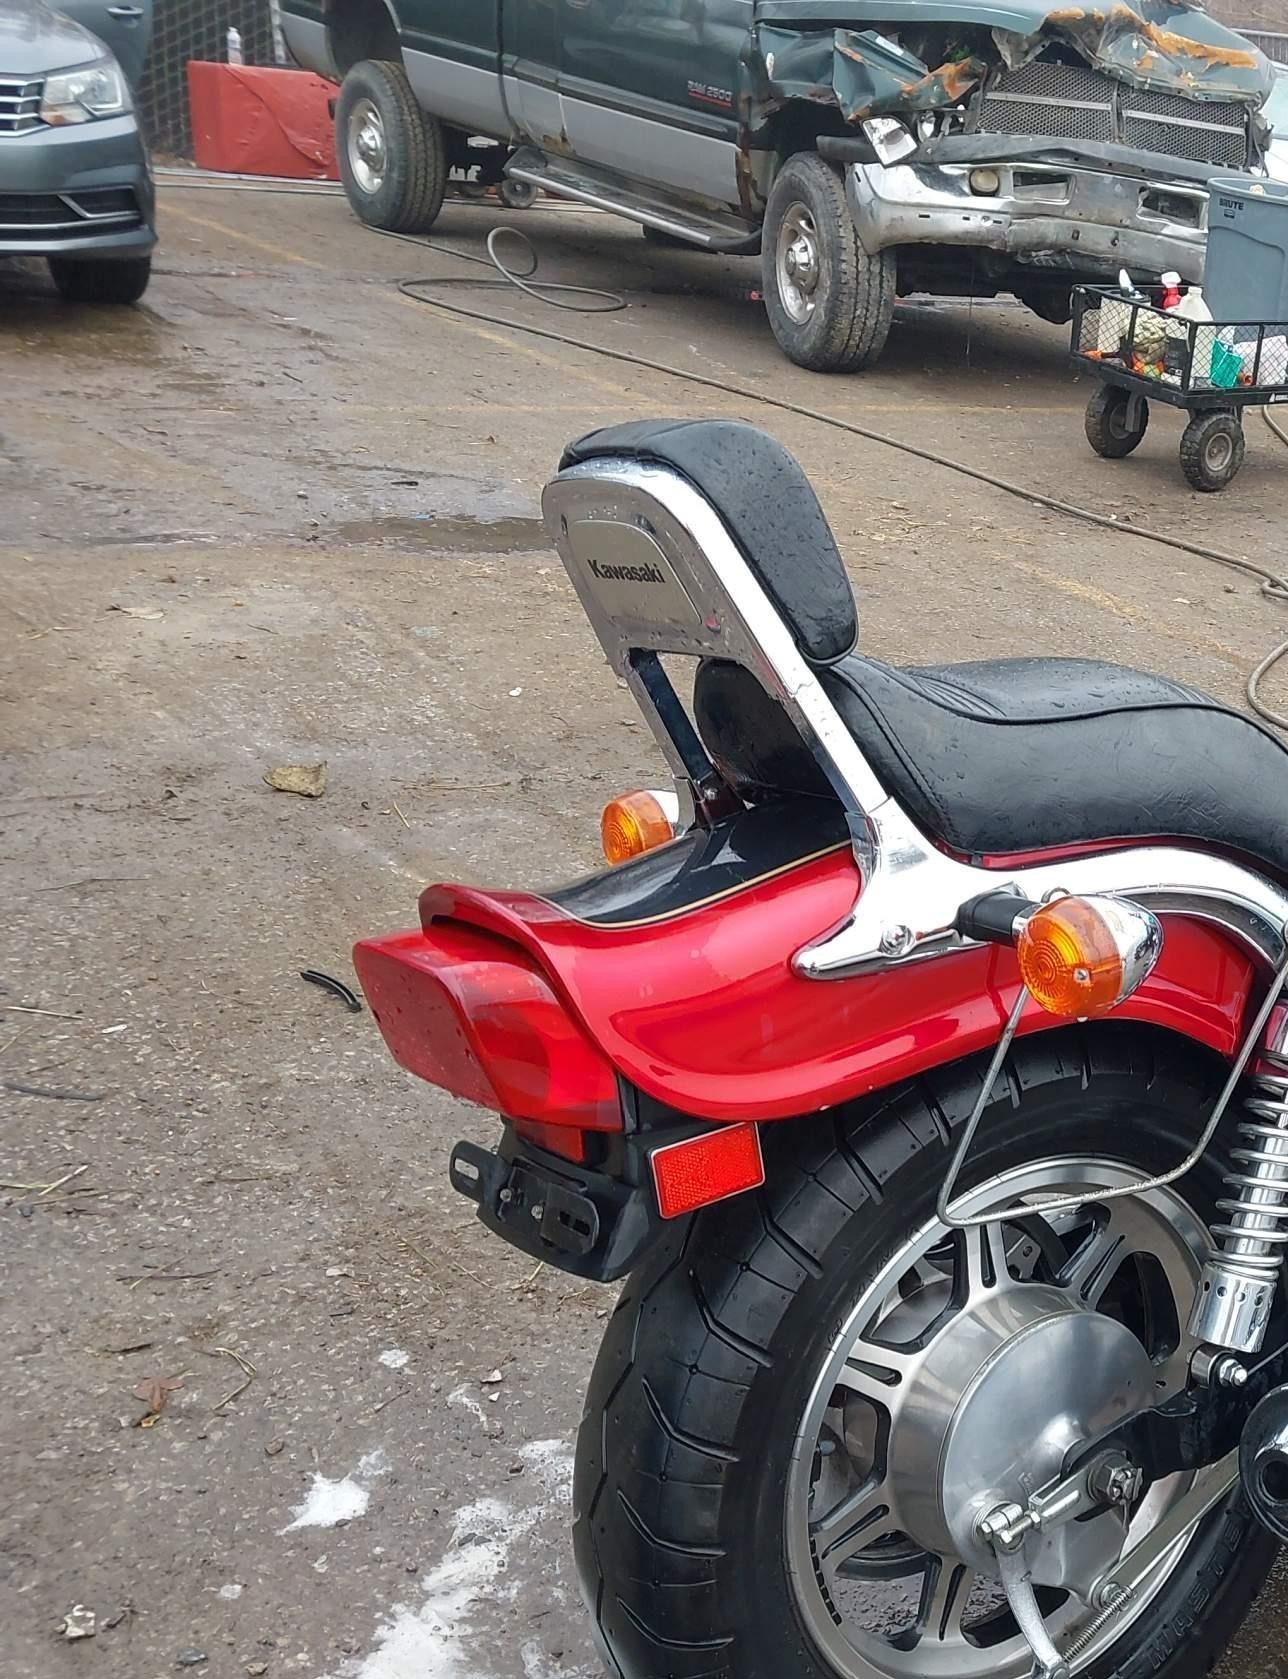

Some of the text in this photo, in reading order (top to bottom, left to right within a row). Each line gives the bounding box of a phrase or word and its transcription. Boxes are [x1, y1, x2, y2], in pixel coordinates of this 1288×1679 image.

[706, 86, 732, 101] 2500
[1219, 198, 1244, 210] BRUTE
[586, 559, 666, 583] Kawasaki
